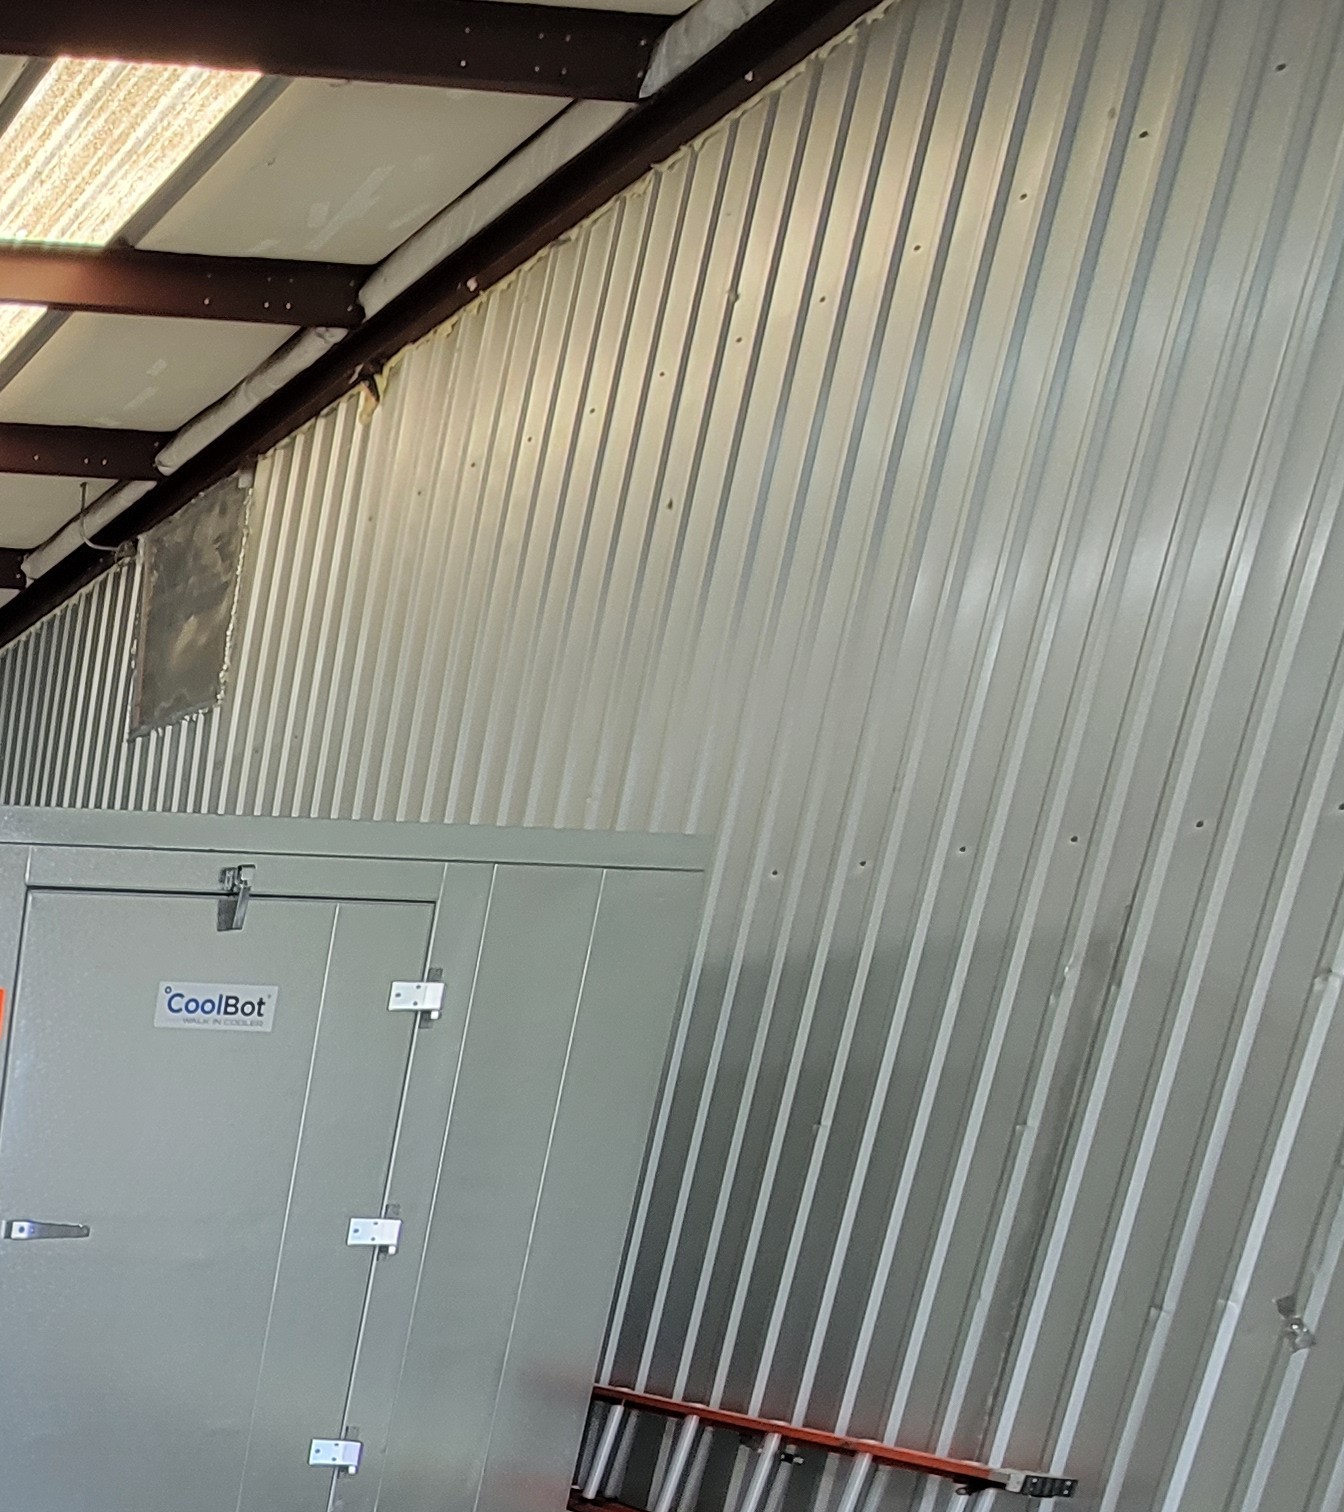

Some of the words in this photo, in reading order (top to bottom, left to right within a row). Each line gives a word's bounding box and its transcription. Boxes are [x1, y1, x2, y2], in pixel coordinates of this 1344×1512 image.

[166, 991, 267, 1018] CoolBot
[182, 1017, 211, 1025] WALK
[211, 1018, 222, 1026] IN
[223, 1018, 265, 1027] COOLER
